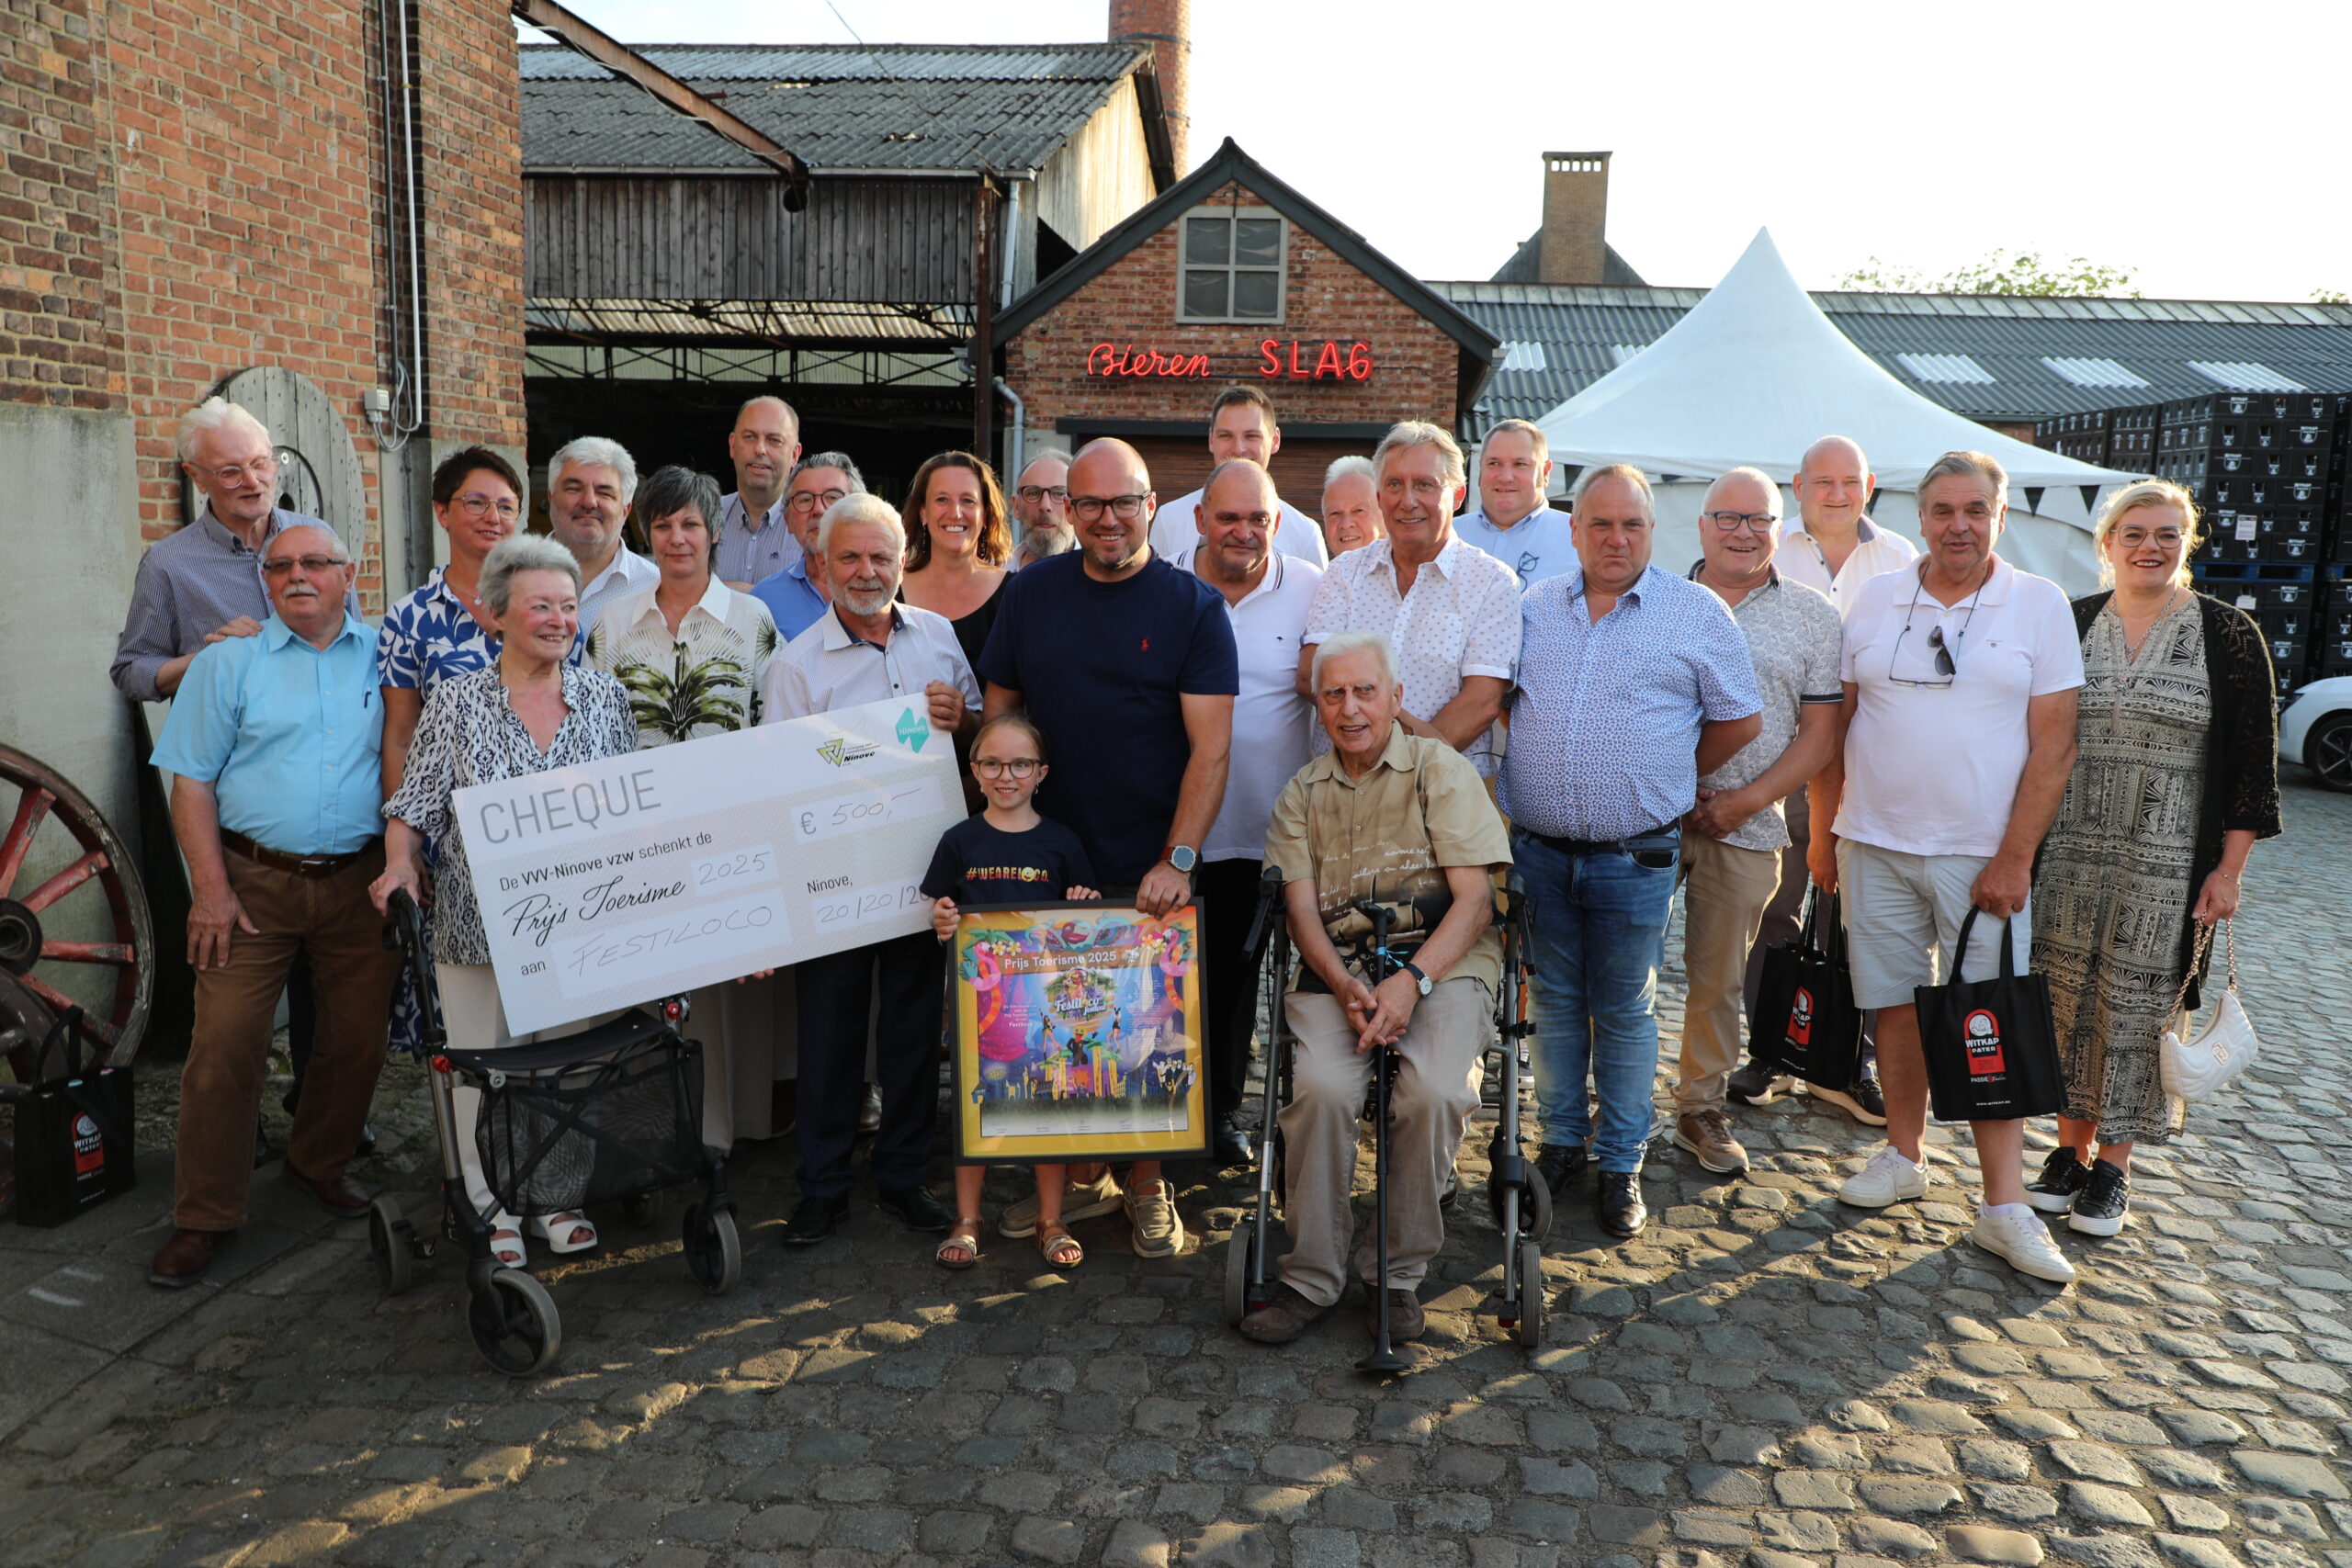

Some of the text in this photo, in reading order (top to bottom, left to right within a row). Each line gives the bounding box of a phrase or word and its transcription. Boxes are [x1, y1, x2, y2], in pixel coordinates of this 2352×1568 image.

[1087, 338, 1374, 381] Bieren SLAG
[899, 725, 926, 736] Ninove
[843, 750, 876, 762] Ninove
[480, 769, 662, 844] CHEQUE
[499, 831, 713, 892] De VVV-Ninove vzw schenkt de
[698, 851, 772, 886] 2025
[807, 874, 853, 895] Ninove,
[503, 874, 686, 947] Prijs Toerisme
[568, 906, 773, 976] FESTILOCO
[520, 960, 547, 976] aan
[1003, 950, 1117, 971] Prijs Toerisme 2025
[1964, 1036, 2000, 1049] WITKAP
[1971, 1045, 1996, 1055] PATER
